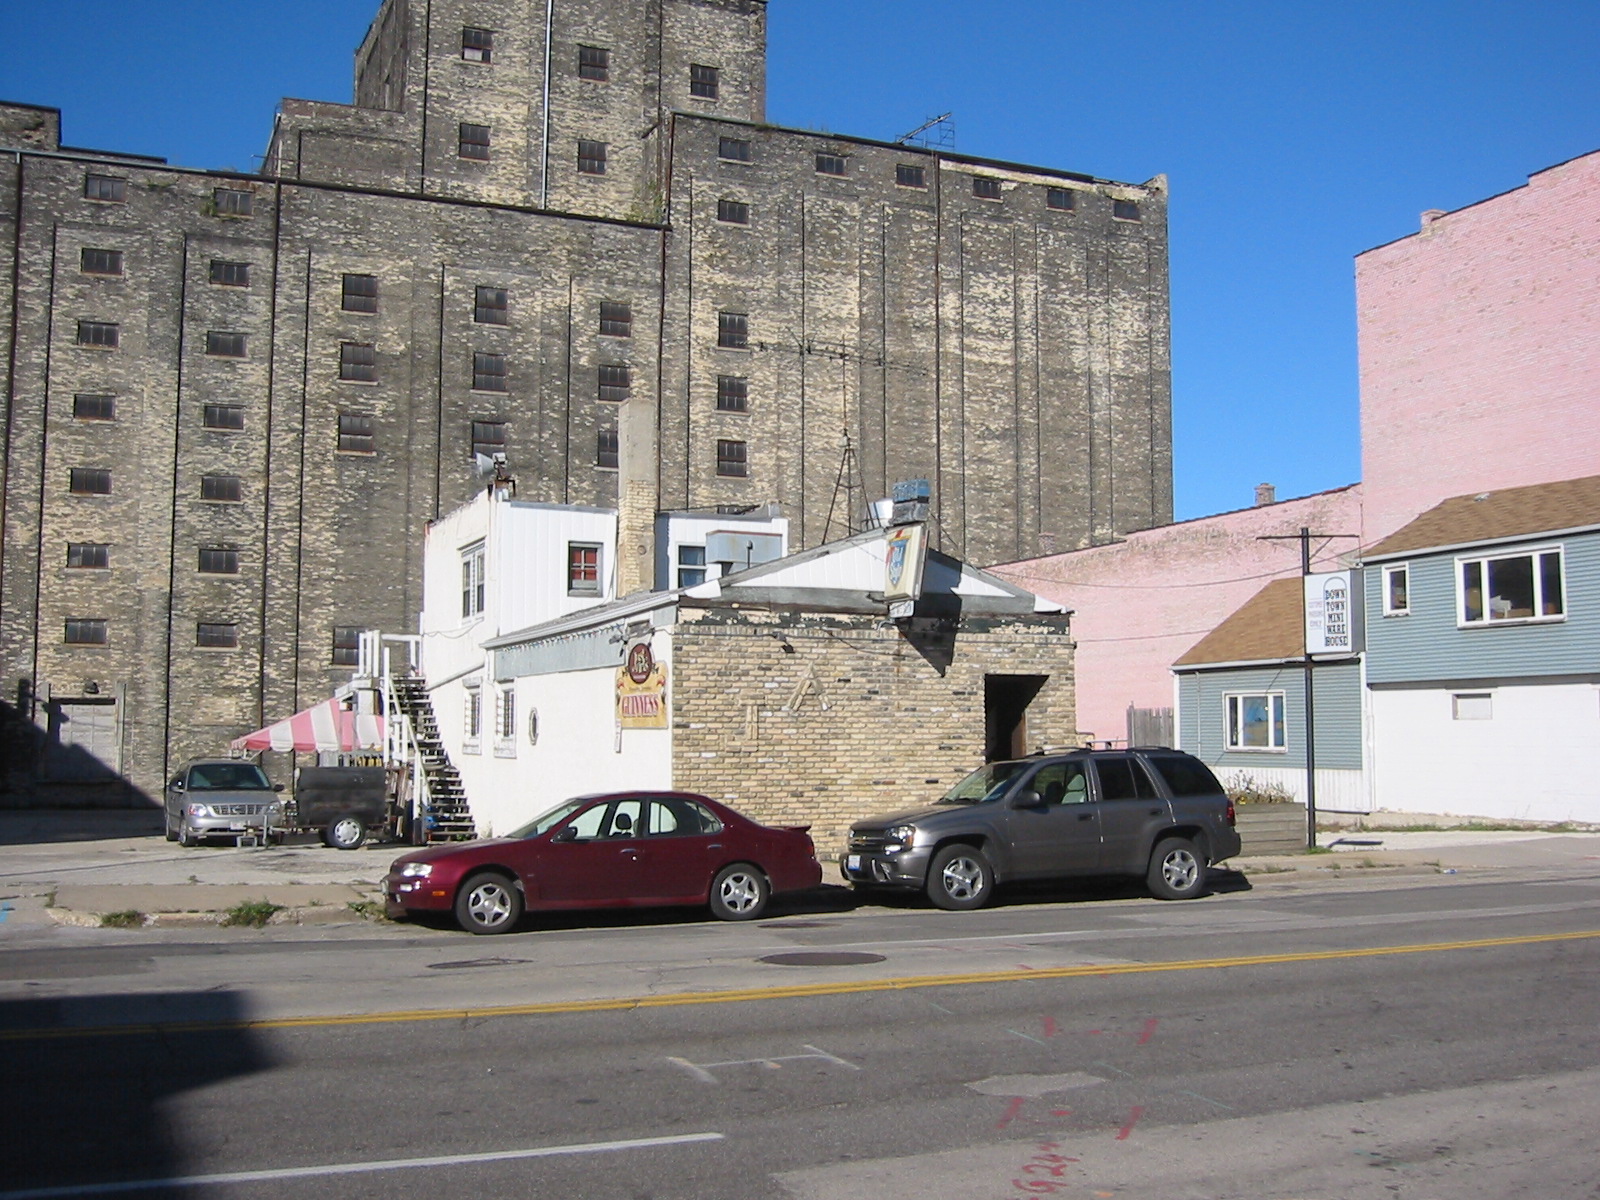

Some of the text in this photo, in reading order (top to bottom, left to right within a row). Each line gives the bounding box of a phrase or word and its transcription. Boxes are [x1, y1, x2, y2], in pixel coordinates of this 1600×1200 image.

[1325, 589, 1345, 600] DOWN
[1326, 601, 1345, 611] TOWN
[1328, 613, 1344, 623] MINI
[1327, 624, 1345, 634] WARE
[1325, 636, 1348, 646] HOUSE
